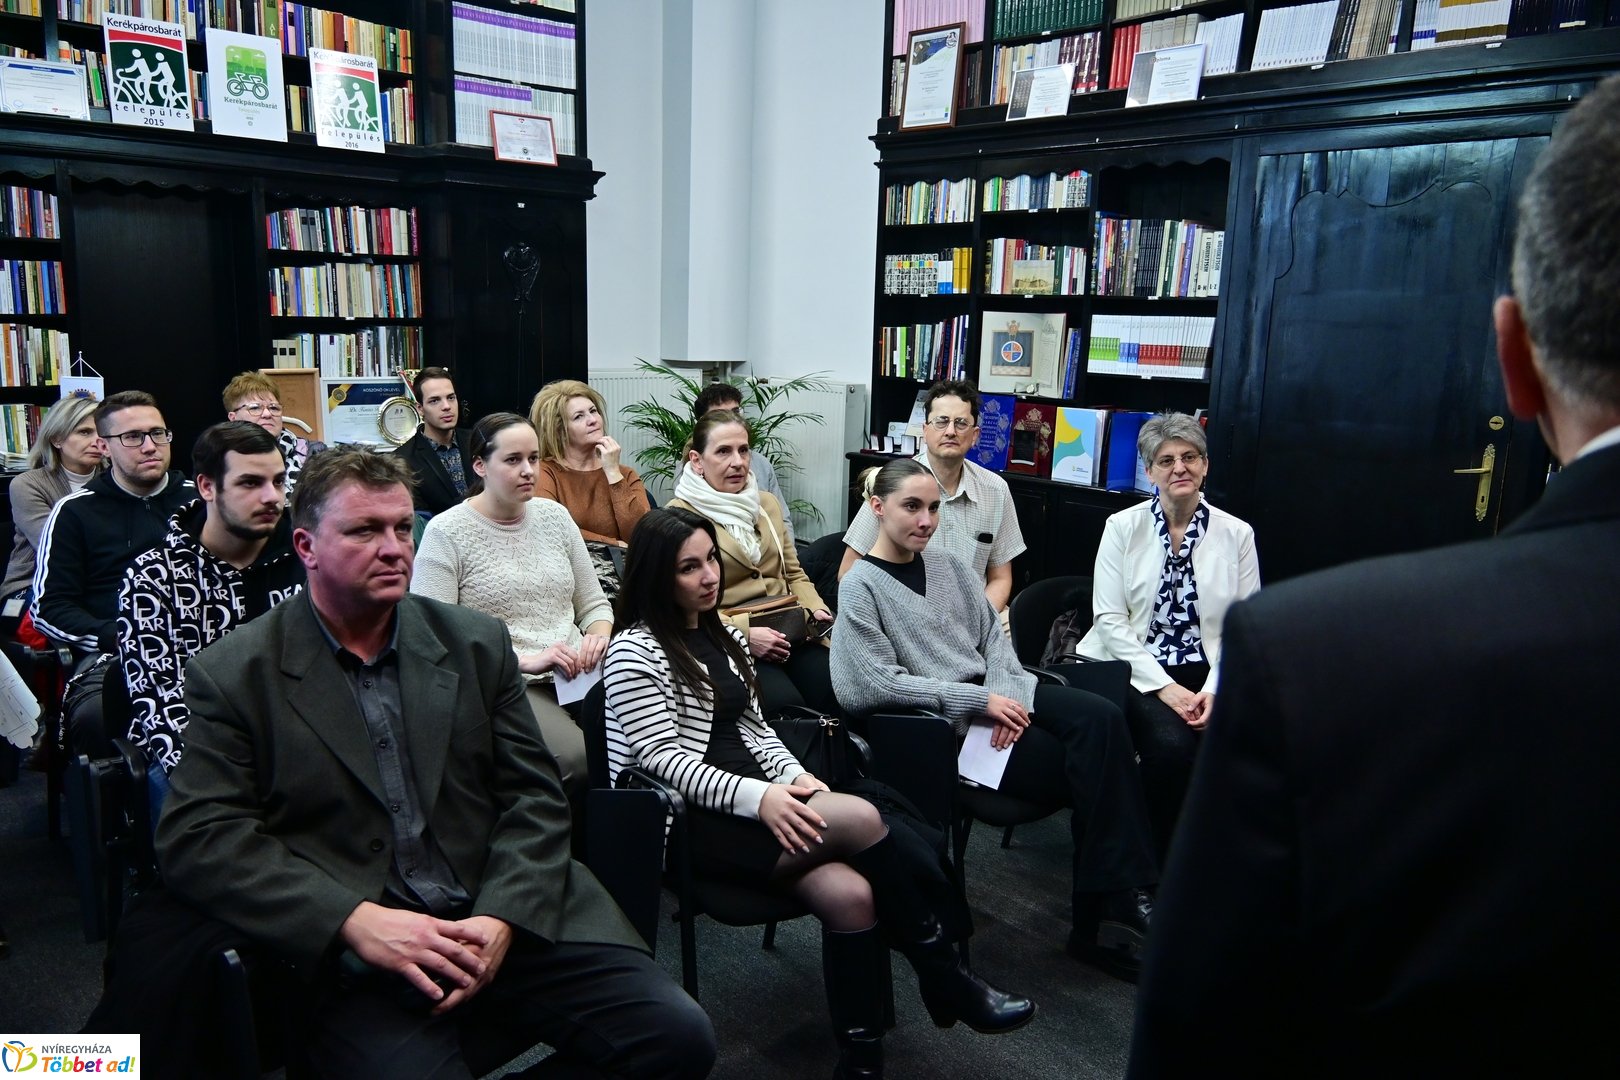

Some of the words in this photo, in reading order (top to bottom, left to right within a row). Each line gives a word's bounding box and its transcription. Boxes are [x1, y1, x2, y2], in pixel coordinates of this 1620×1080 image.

[106, 16, 182, 38] Kerékpárosbarát
[115, 103, 190, 120] település
[143, 117, 165, 127] 2015
[345, 141, 359, 149] 2016
